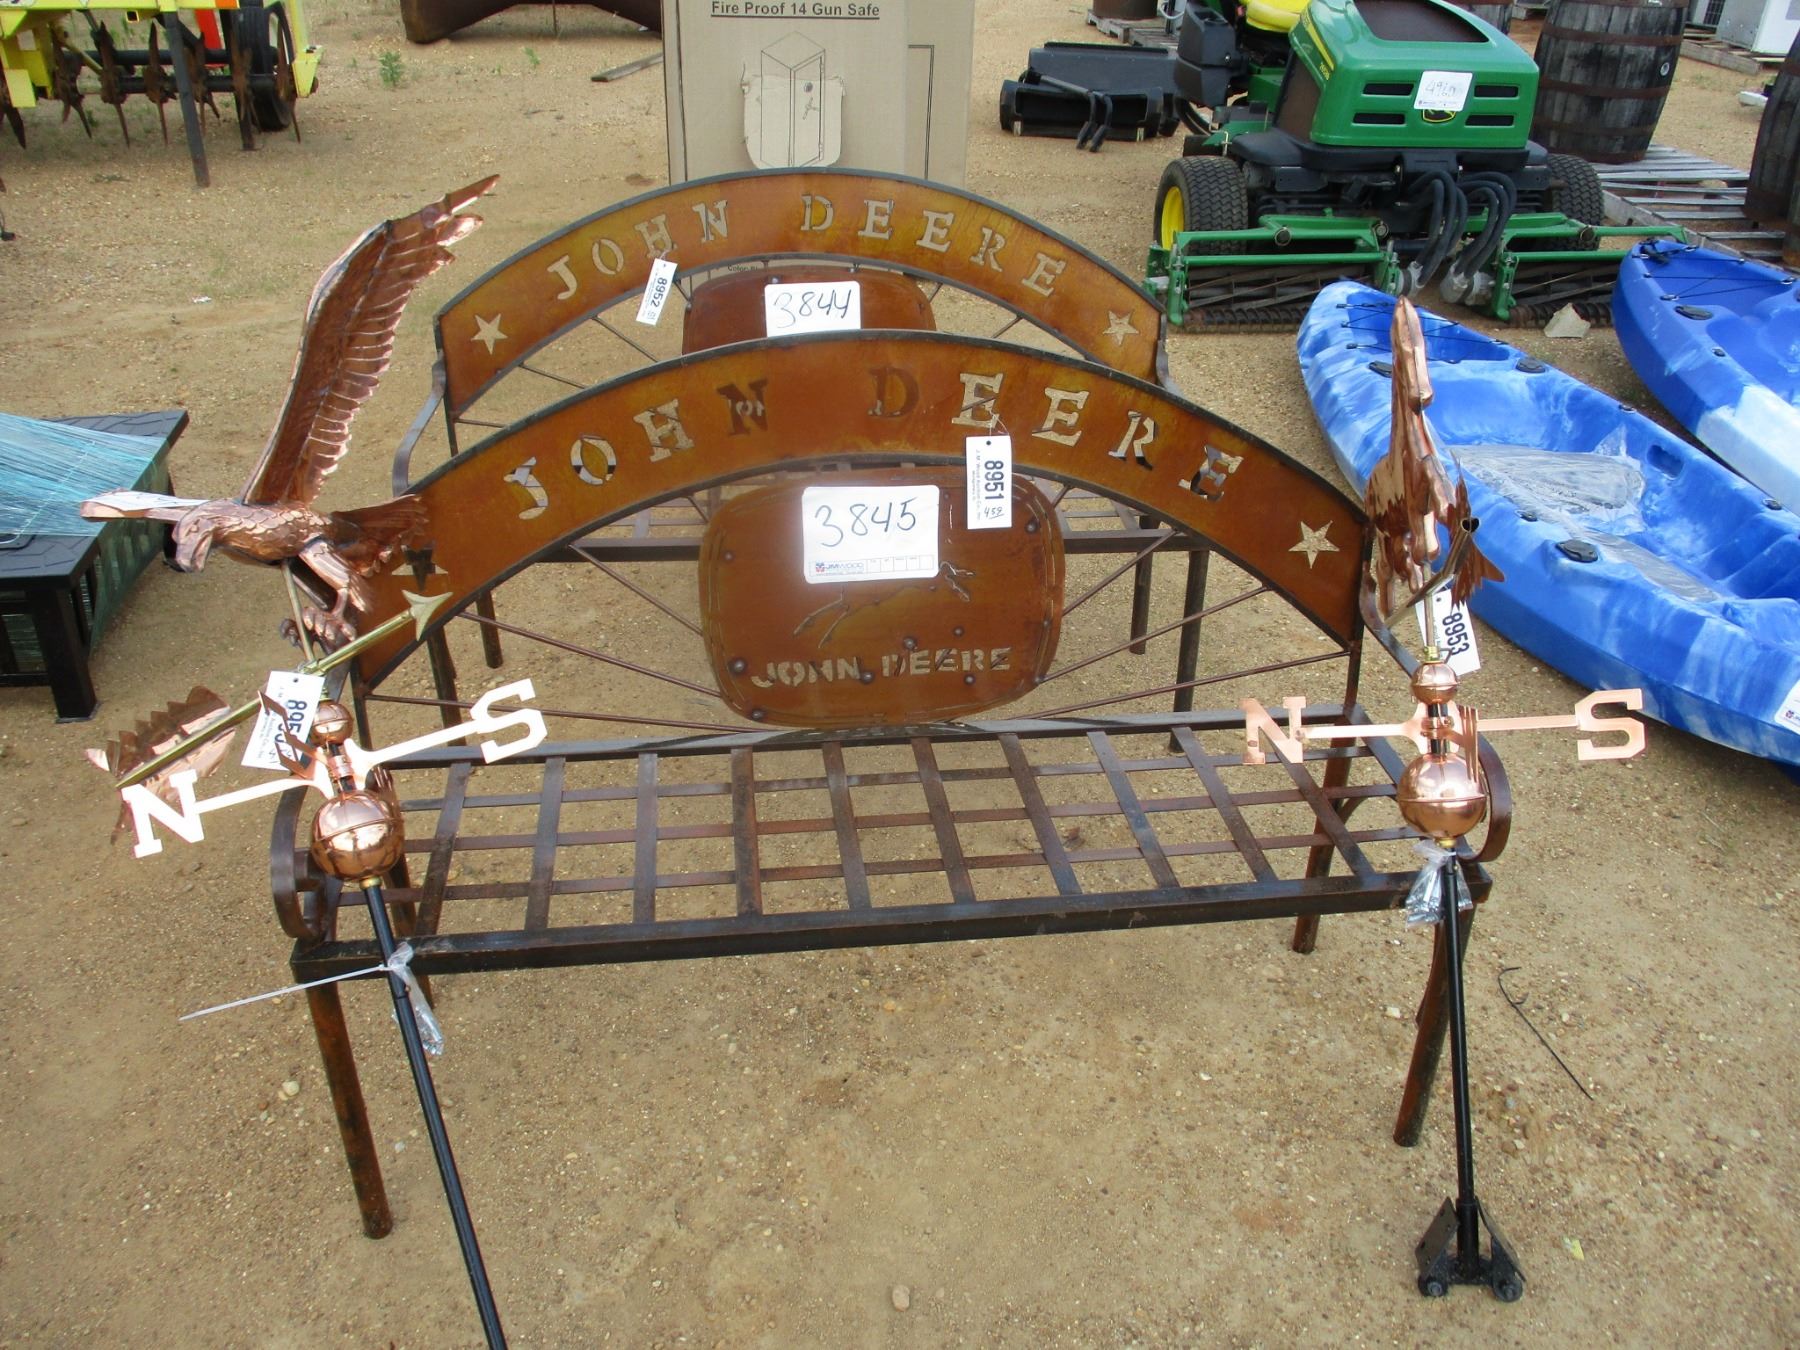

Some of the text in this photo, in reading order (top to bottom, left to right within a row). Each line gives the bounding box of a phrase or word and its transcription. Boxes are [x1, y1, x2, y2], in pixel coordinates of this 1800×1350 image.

[711, 2, 880, 16] Fire Proof 14 Gun Safe
[547, 200, 728, 300] JOHN
[800, 194, 1066, 297] DEERE
[650, 277, 668, 308] 8952
[773, 289, 852, 329] 3844
[503, 366, 1244, 521] JOHN DEERE
[984, 460, 1005, 499] 8951
[815, 496, 918, 548] 3845
[1442, 612, 1470, 656] 8953
[751, 647, 1011, 688] JOHN DEERE
[469, 678, 548, 764] S
[1240, 695, 1307, 766] N
[1575, 688, 1647, 761] S
[121, 769, 205, 858] N
